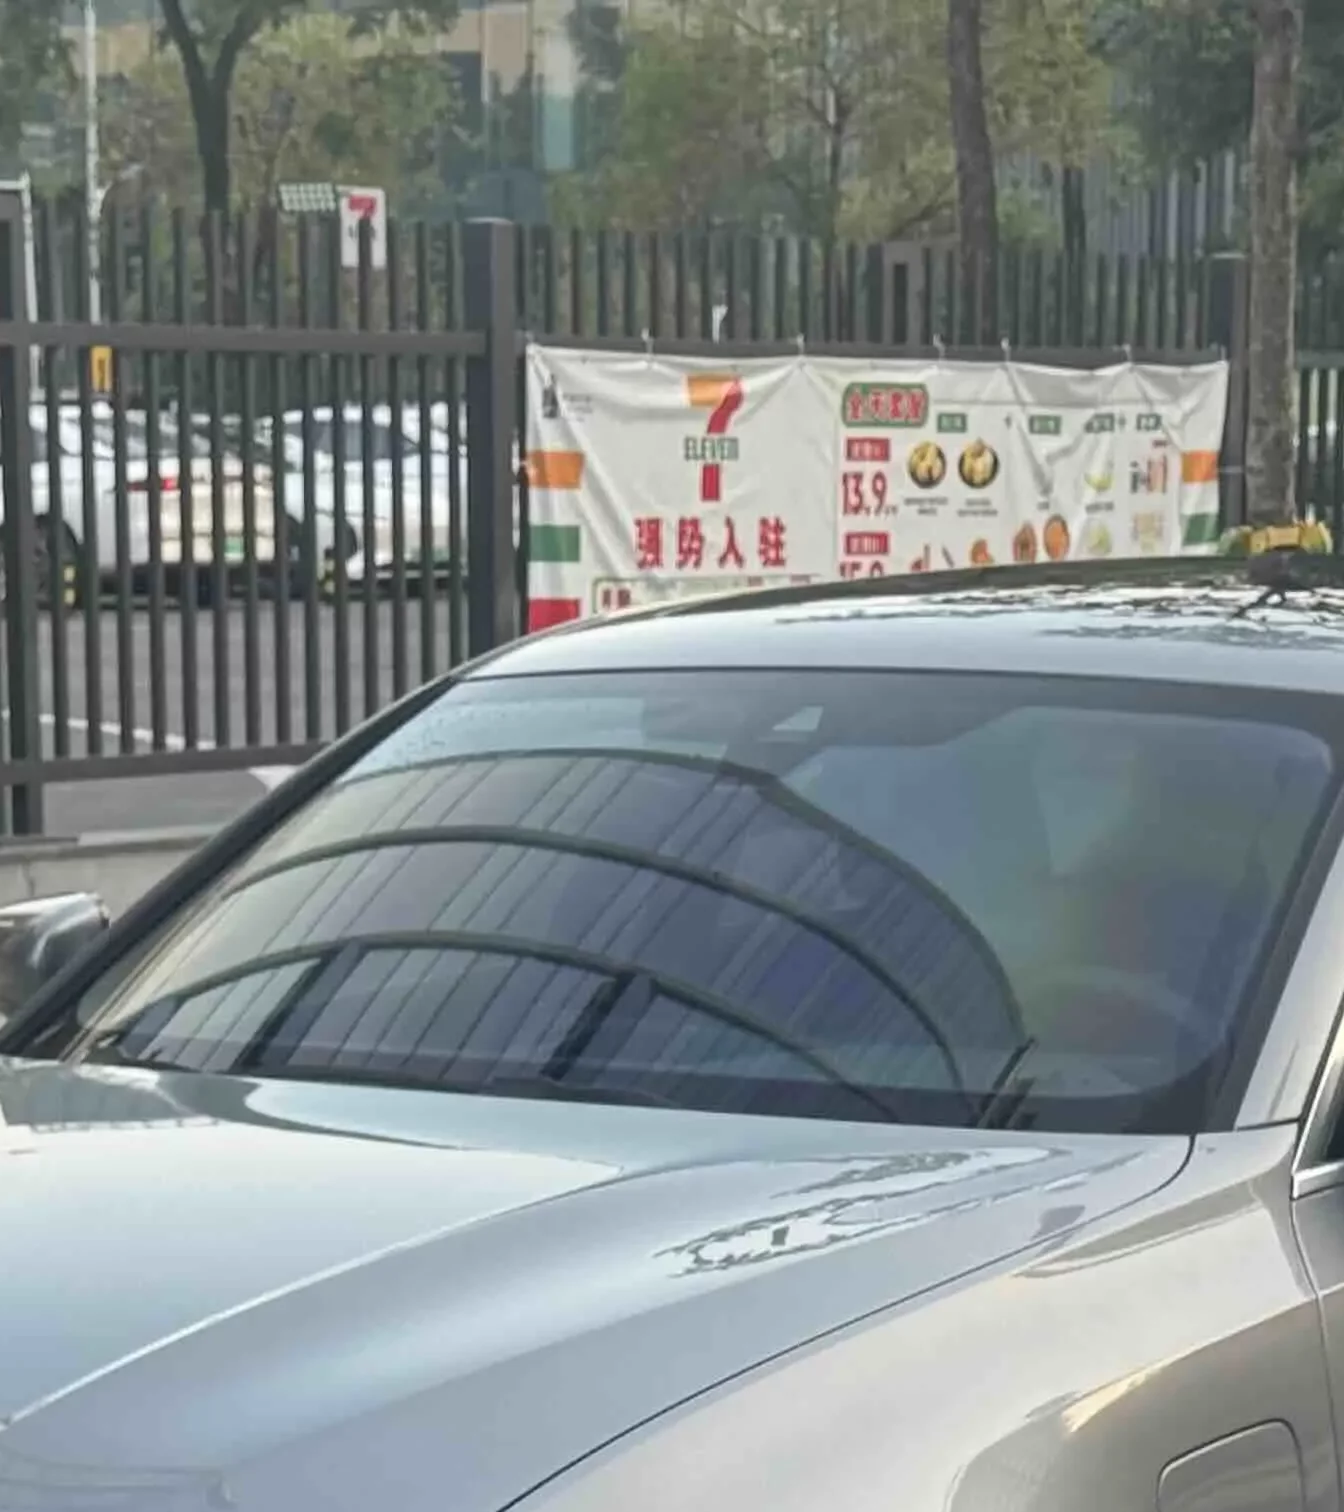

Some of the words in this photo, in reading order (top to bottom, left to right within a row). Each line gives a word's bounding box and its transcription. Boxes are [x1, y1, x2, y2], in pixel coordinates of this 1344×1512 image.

[685, 372, 744, 501] 7
[635, 516, 786, 569] 强势入驻
